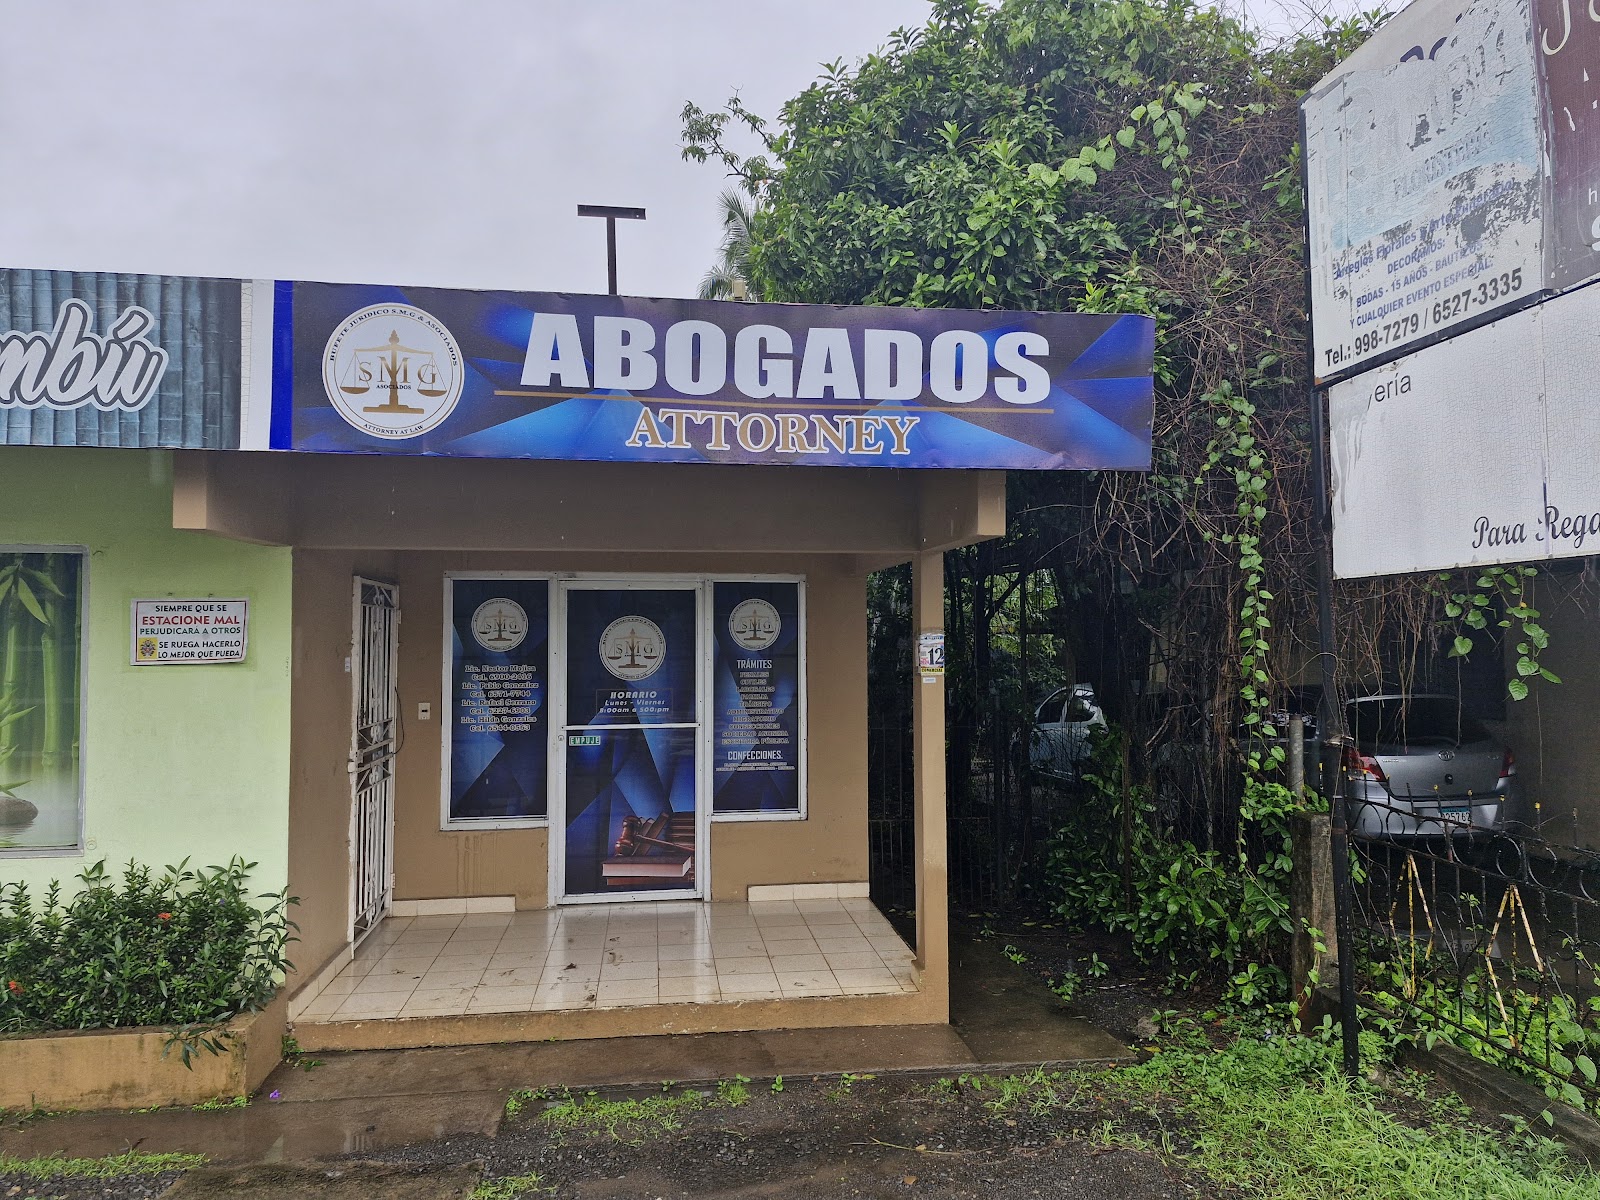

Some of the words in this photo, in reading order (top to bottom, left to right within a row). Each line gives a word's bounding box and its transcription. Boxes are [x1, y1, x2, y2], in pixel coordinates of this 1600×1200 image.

[1387, 238, 1446, 274] DECORAMOS:
[1357, 286, 1384, 308] BODAS
[1391, 279, 1401, 292] 15
[1350, 319, 1356, 329] Y
[1357, 298, 1404, 326] CUALQUIER
[1407, 280, 1440, 305] EVENTO
[1325, 345, 1351, 367] Tel.:
[1355, 312, 1419, 356] 998-7279
[1432, 268, 1523, 324] 6527-3335
[330, 327, 349, 361] BUFETE
[350, 309, 389, 327] JURIDICO
[425, 320, 458, 366] ASOCIADOS
[520, 312, 1050, 404] ABOGADOS
[364, 423, 398, 434] ATTORNEY
[409, 425, 423, 433] LAW
[626, 407, 920, 455] ATTORNEY
[1472, 516, 1527, 548] Para
[195, 604, 214, 613] QUE
[217, 604, 227, 612] SE
[142, 615, 210, 625] ESTACIONE
[214, 615, 240, 624] MAL
[140, 626, 200, 635] PERJUDICARÁ
[202, 640, 240, 648] HACERLO
[197, 650, 213, 659] QUE
[736, 658, 772, 668] TRÁMITES
[928, 648, 944, 665] 12
[610, 691, 657, 699] HORARIO
